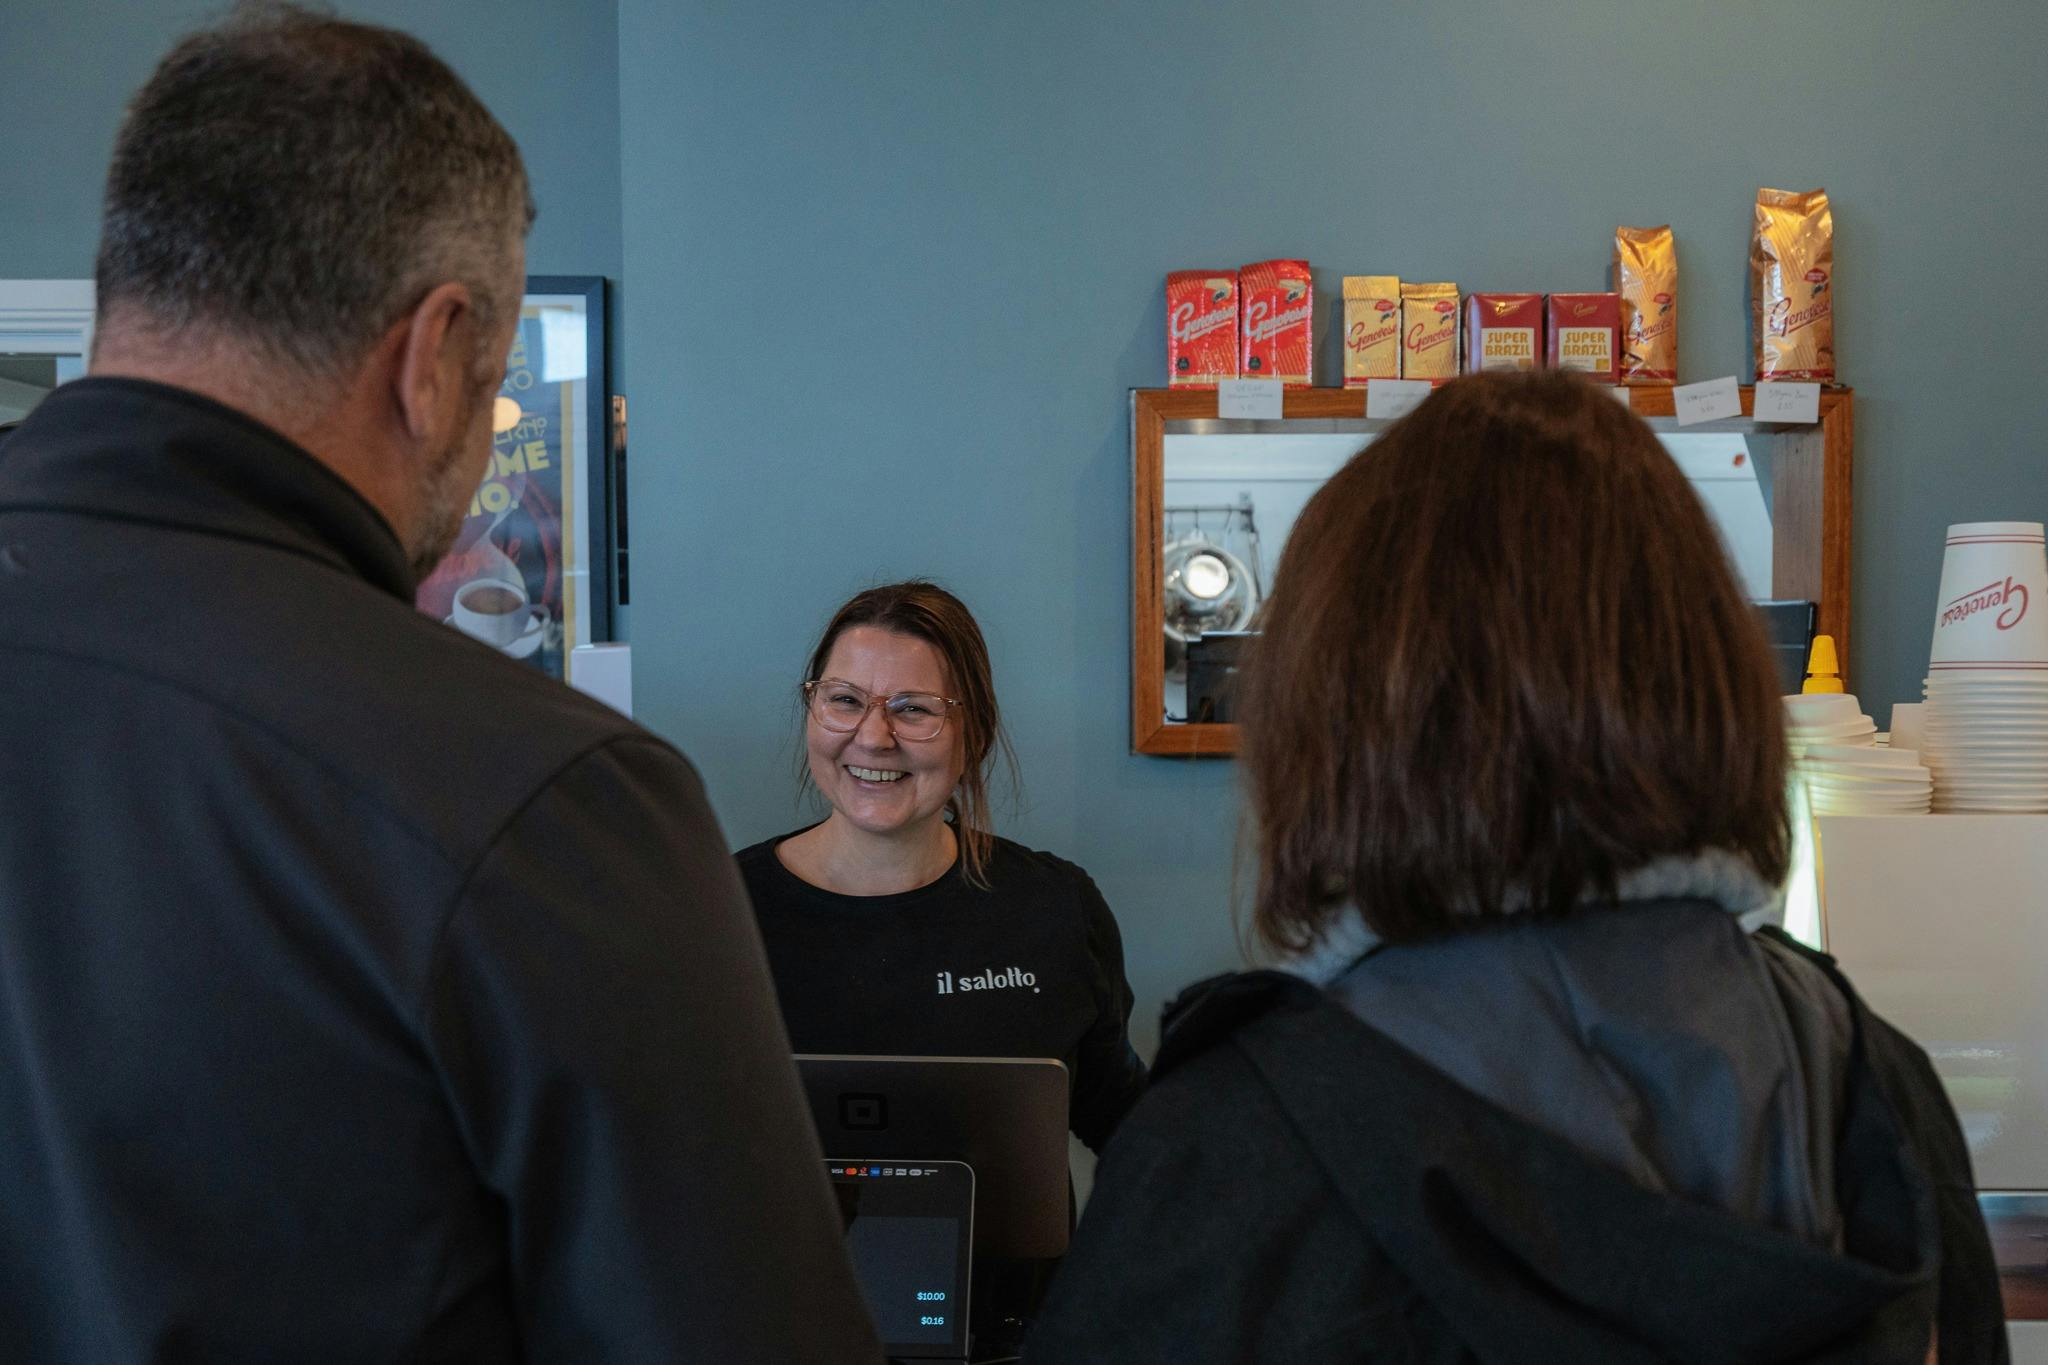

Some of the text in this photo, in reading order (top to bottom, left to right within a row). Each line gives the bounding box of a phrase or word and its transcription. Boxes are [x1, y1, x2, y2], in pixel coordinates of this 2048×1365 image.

[1487, 332, 1529, 343] SUPER
[1565, 332, 1607, 343] SUPER
[1485, 345, 1531, 356] BRAZIL
[1562, 345, 1608, 356] BRAZIL
[937, 971, 954, 994] il
[917, 1292, 946, 1301] $10.00
[921, 1317, 944, 1325] $0.16
